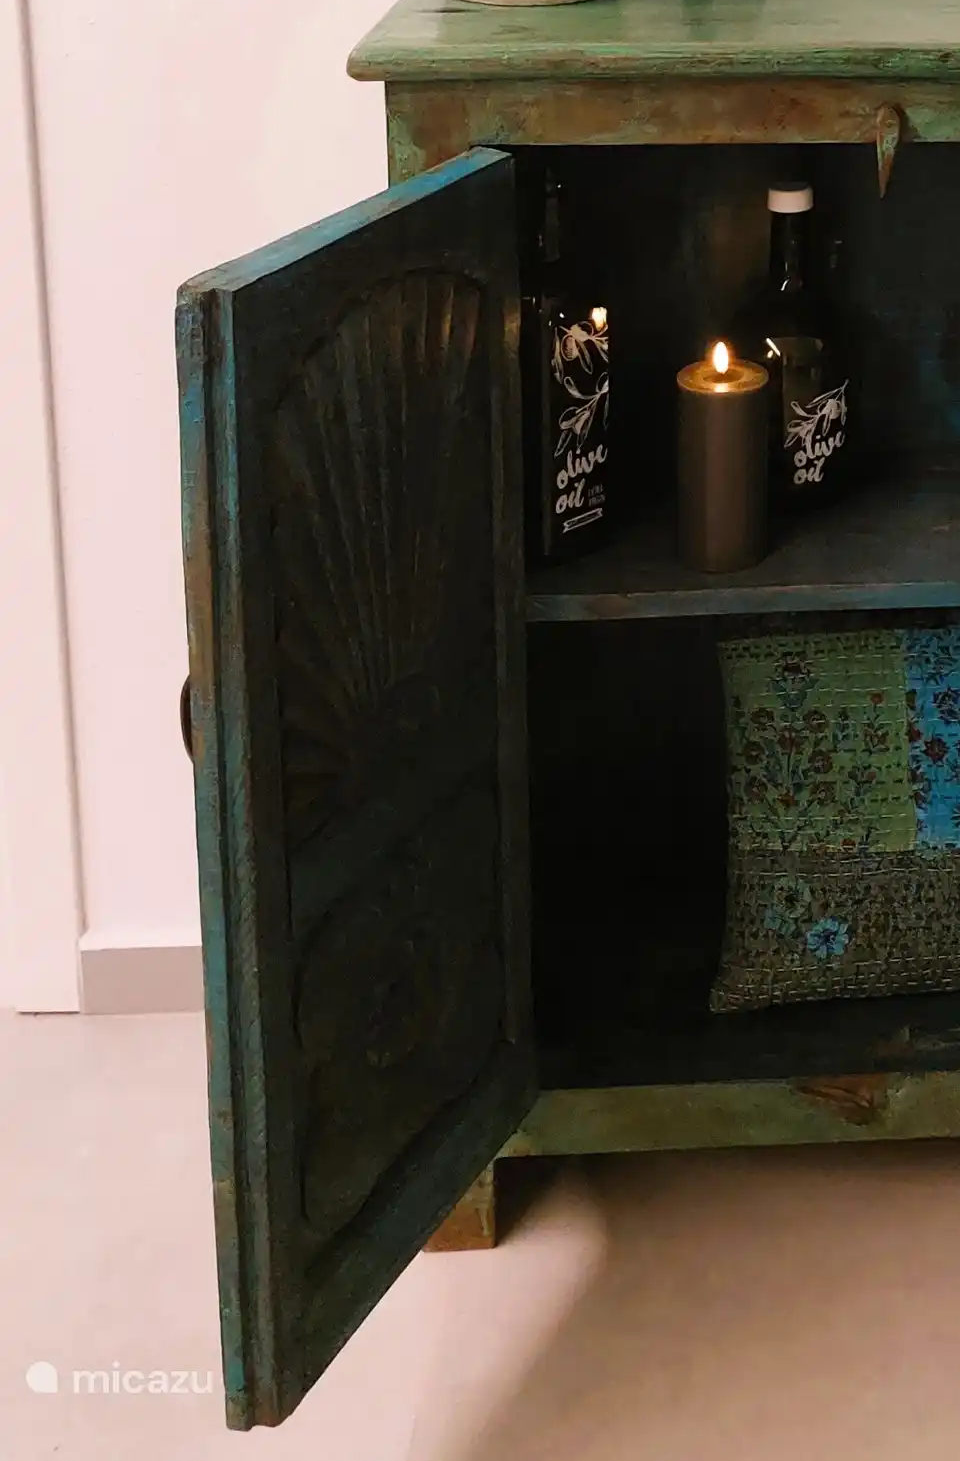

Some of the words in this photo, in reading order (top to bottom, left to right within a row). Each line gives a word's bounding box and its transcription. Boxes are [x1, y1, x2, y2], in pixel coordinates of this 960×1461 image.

[556, 443, 609, 490] olive
[794, 431, 846, 468] olive
[794, 457, 826, 485] oil
[555, 477, 586, 514] oil
